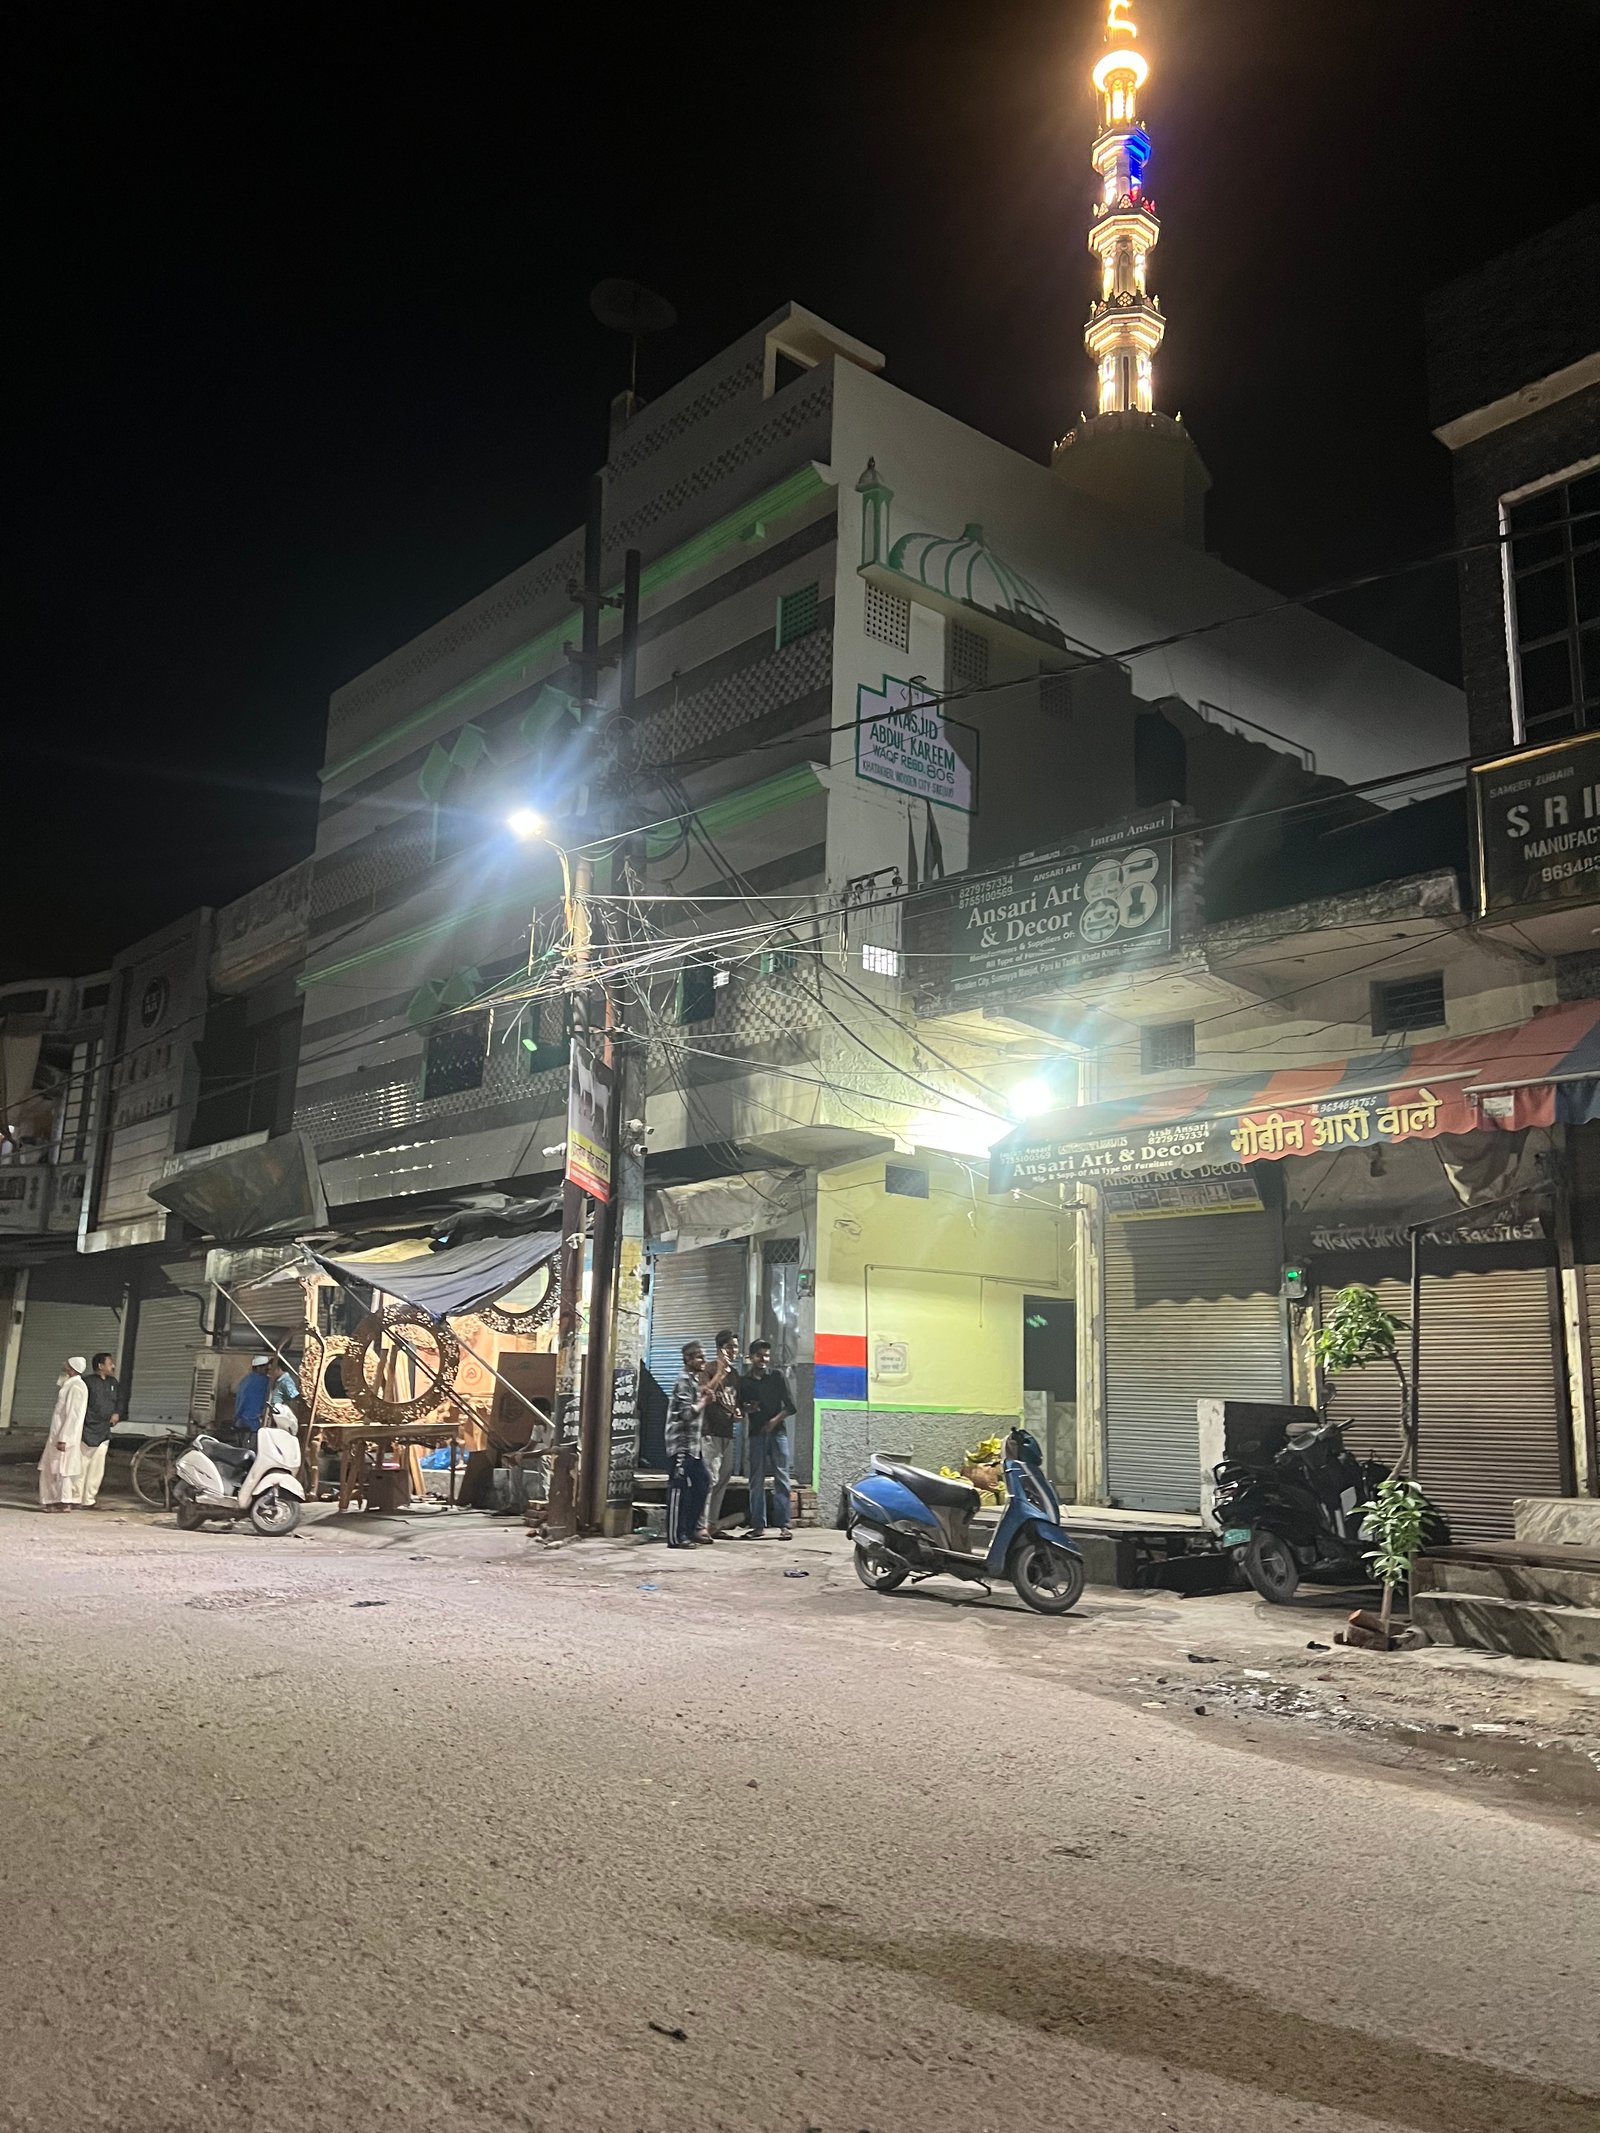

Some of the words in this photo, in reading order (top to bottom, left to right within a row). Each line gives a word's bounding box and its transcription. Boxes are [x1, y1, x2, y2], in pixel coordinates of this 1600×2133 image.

[888, 706, 938, 740] MASJID
[870, 723, 906, 752] ABDUL
[911, 738, 955, 772] KAREEM
[873, 744, 899, 765] WAQF
[927, 765, 955, 785] 806
[1490, 779, 1532, 799] SAMEER
[1536, 767, 1575, 786] ZUBAIR
[1584, 784, 1600, 819] I
[1091, 832, 1124, 848] Imran
[1127, 817, 1165, 838] Ansari
[960, 875, 1013, 899] 8279757334
[1033, 869, 1064, 882] ANSARI
[1066, 863, 1082, 874] ART
[966, 893, 1038, 930] Ansari
[1044, 883, 1082, 910] Art
[981, 927, 1001, 948] &
[1006, 912, 1073, 943] Decor
[1028, 935, 1062, 949] Suppliers
[1148, 1130, 1174, 1139] Arsh
[1176, 1122, 1209, 1135] Ansari
[1148, 1131, 1209, 1145] 8279757334
[1231, 1117, 1305, 1156] मोबीन
[1311, 1108, 1371, 1146] आरी
[1377, 1088, 1443, 1136] वाले
[1014, 1157, 1075, 1178] Ansari
[1081, 1150, 1113, 1169] Art
[1119, 1147, 1136, 1163] &
[1141, 1140, 1205, 1162] Decor
[1026, 1145, 1052, 1155] Ansari
[1102, 1167, 1121, 1177] Type
[1135, 1160, 1174, 1171] Furniture
[1104, 1172, 1150, 1187] Ansari
[1201, 1162, 1248, 1178] Decor
